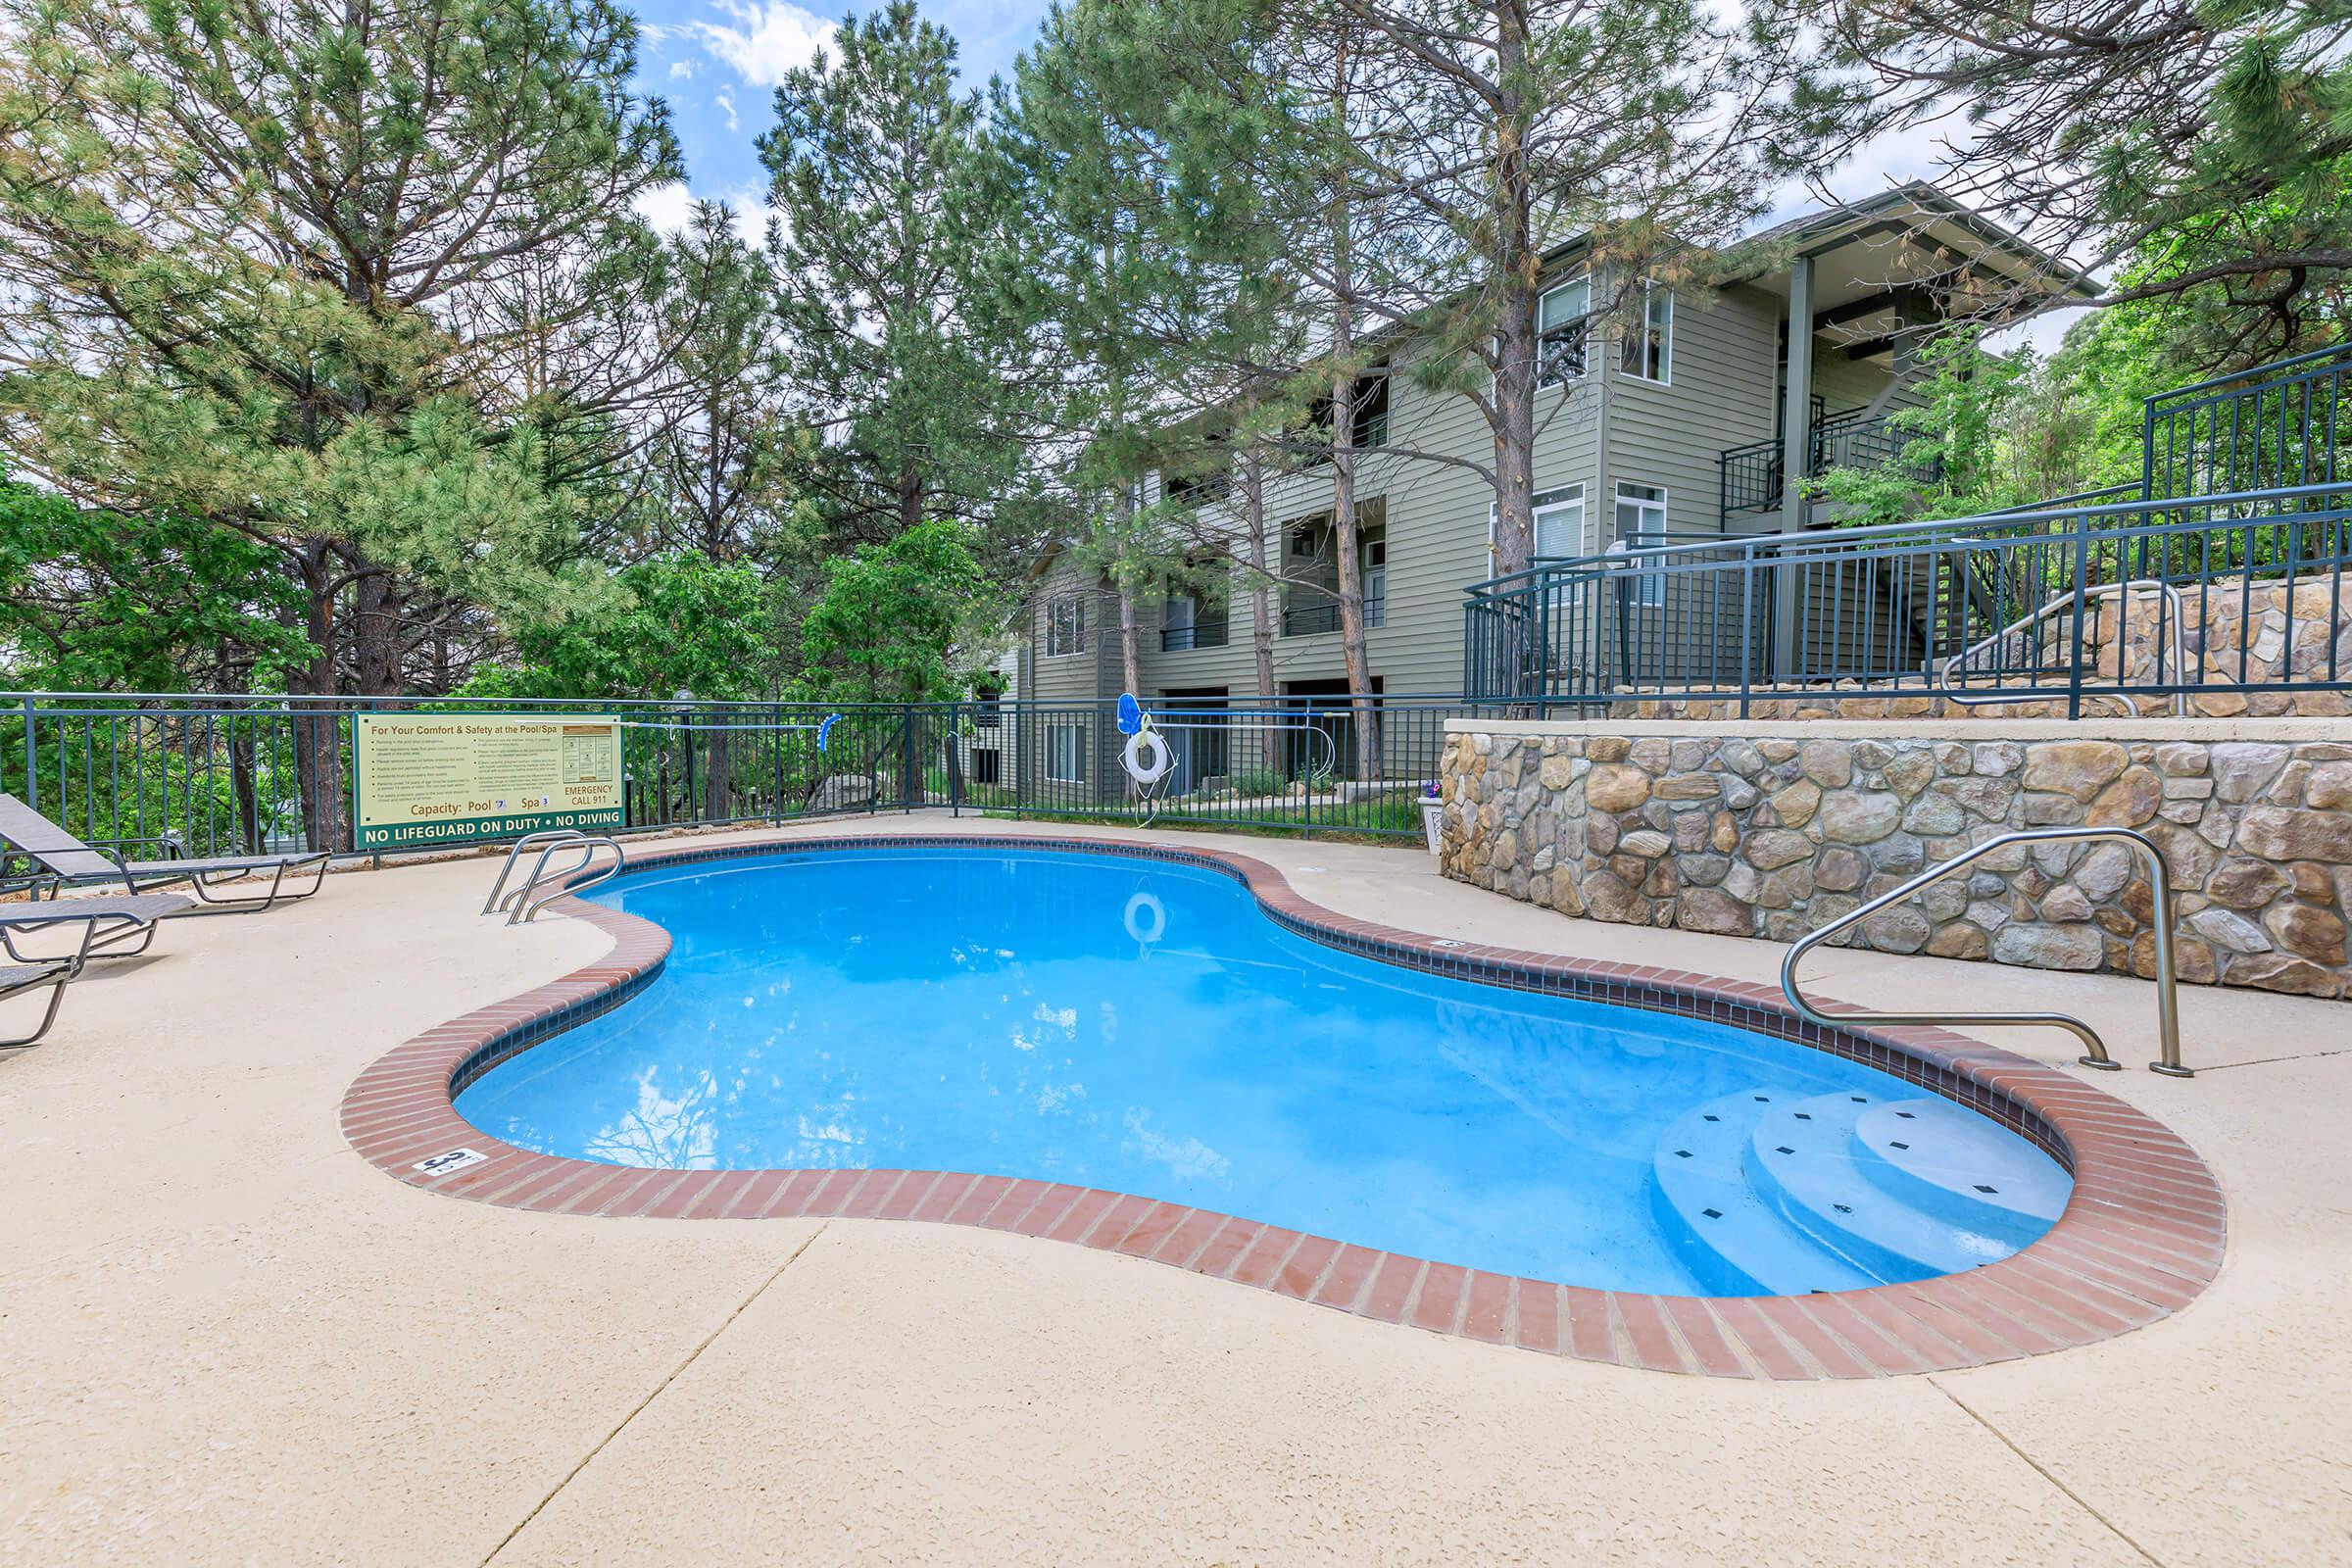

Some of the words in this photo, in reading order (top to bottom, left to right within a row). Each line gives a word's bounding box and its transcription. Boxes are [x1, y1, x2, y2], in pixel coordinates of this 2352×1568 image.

[371, 725, 388, 735] For
[392, 725, 415, 735] Your
[416, 725, 454, 735] Comfort
[457, 725, 464, 735] &
[466, 725, 493, 736] Safety
[505, 725, 518, 734] the
[520, 725, 558, 735] Pool/Spa
[564, 785, 612, 796] EMERGENCY
[572, 795, 591, 806] CALL
[593, 795, 607, 805] 911
[411, 803, 463, 817] Capacity:
[468, 800, 491, 812] Pool
[521, 798, 540, 810] Spa
[366, 830, 388, 843] NO
[395, 822, 475, 841] LIFEGUARD
[481, 821, 502, 833] ON
[506, 817, 541, 831] DUTY
[556, 815, 577, 827] NO
[578, 811, 619, 825] DIVING
